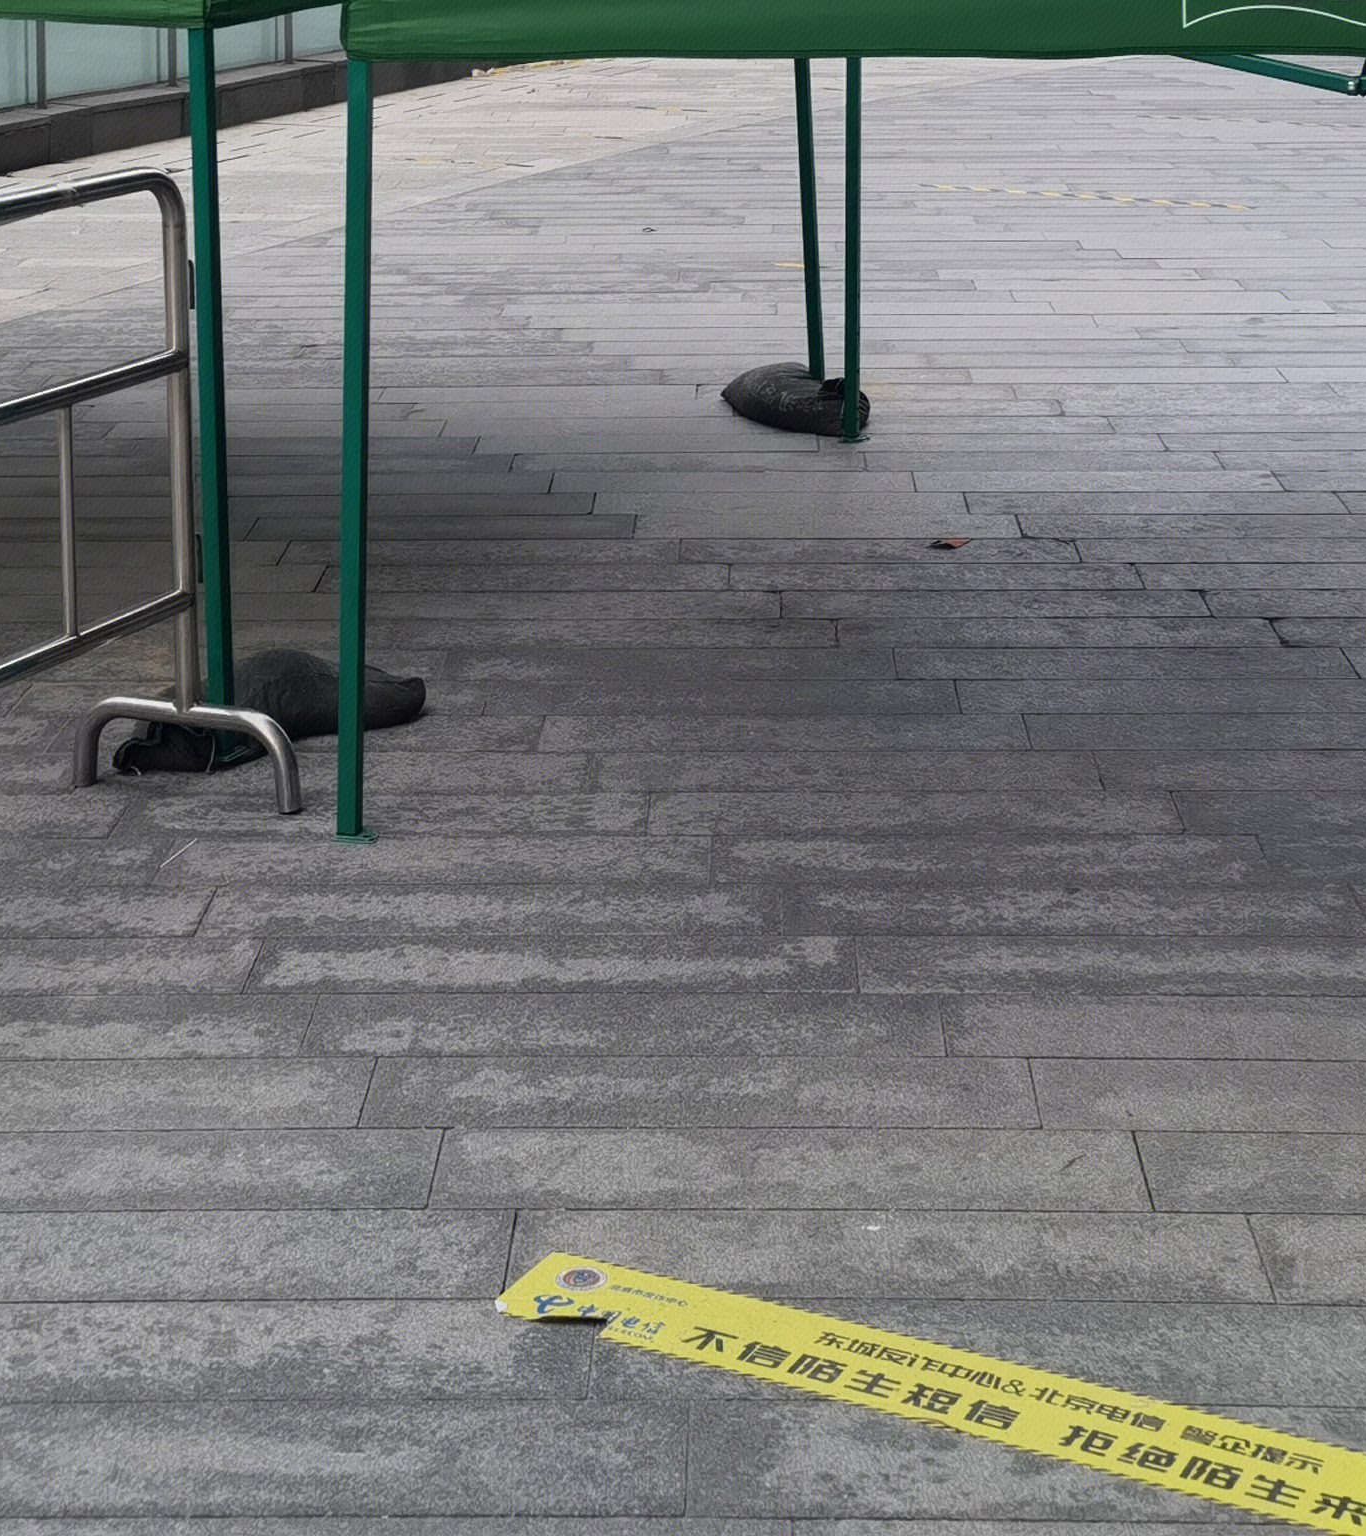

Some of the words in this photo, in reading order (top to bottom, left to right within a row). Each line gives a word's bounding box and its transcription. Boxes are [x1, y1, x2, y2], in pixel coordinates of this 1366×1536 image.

[682, 1325, 1022, 1431] 不信陌生短信
